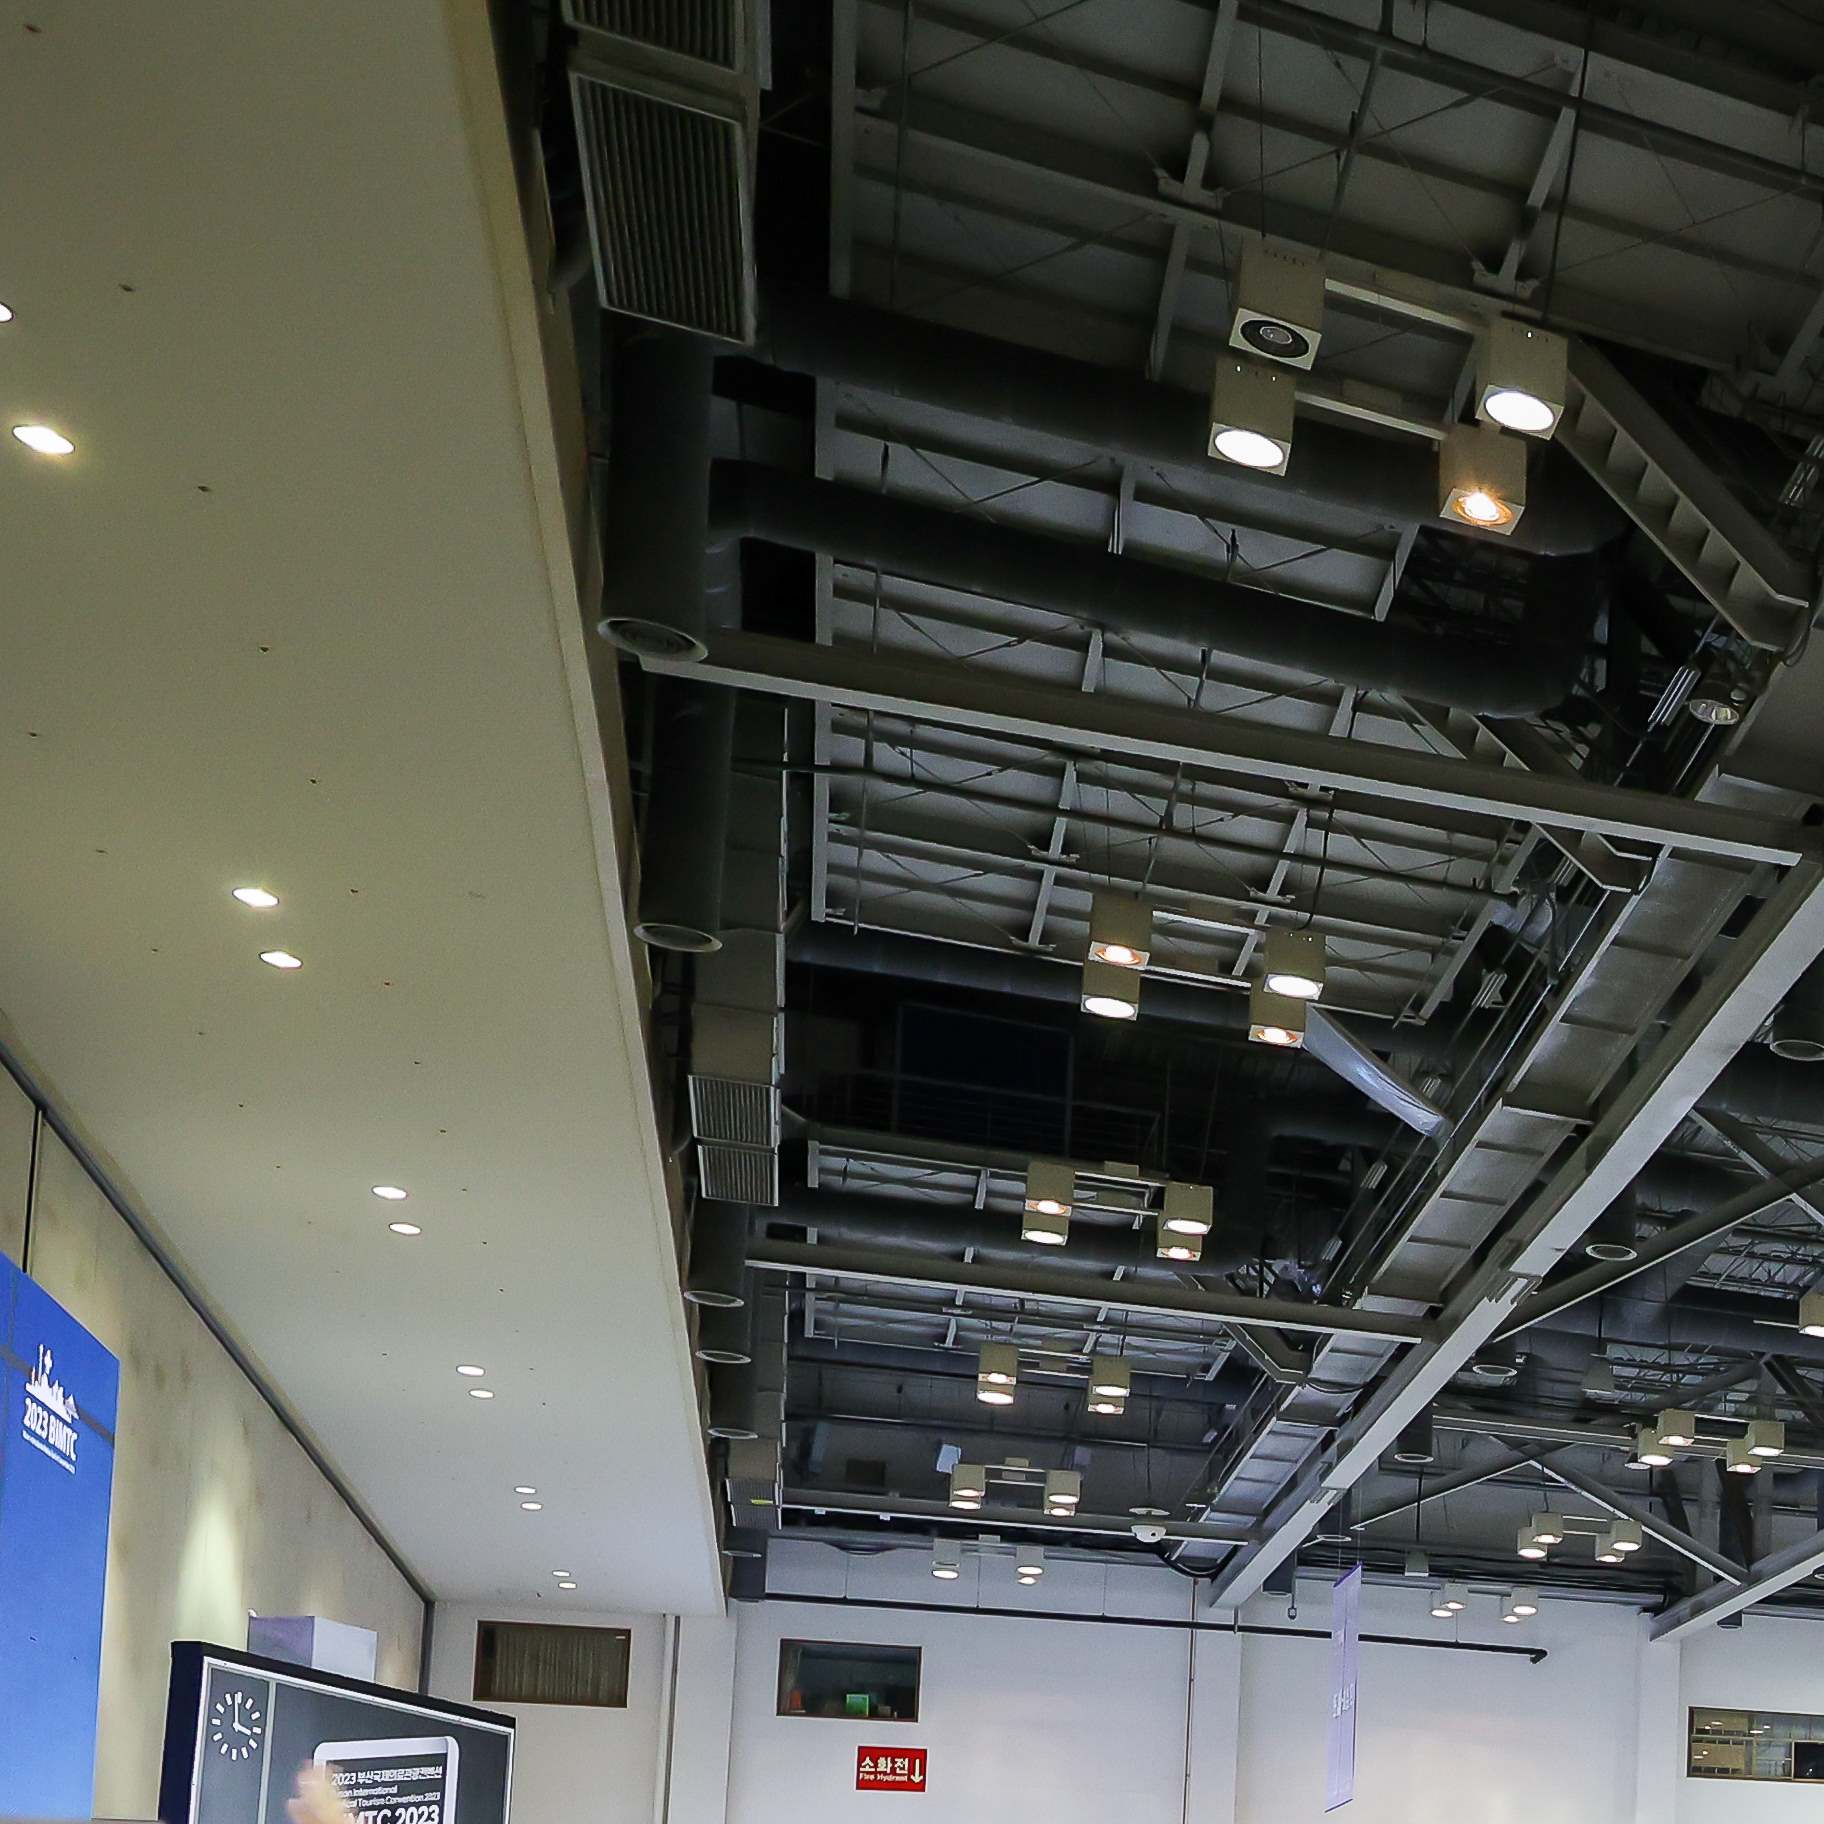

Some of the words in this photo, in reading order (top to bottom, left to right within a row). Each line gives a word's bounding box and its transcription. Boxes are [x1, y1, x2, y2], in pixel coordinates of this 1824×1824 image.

[23, 1398, 50, 1440] 2023
[49, 1414, 78, 1461] BIMTC
[860, 1756, 909, 1775] 소화전
